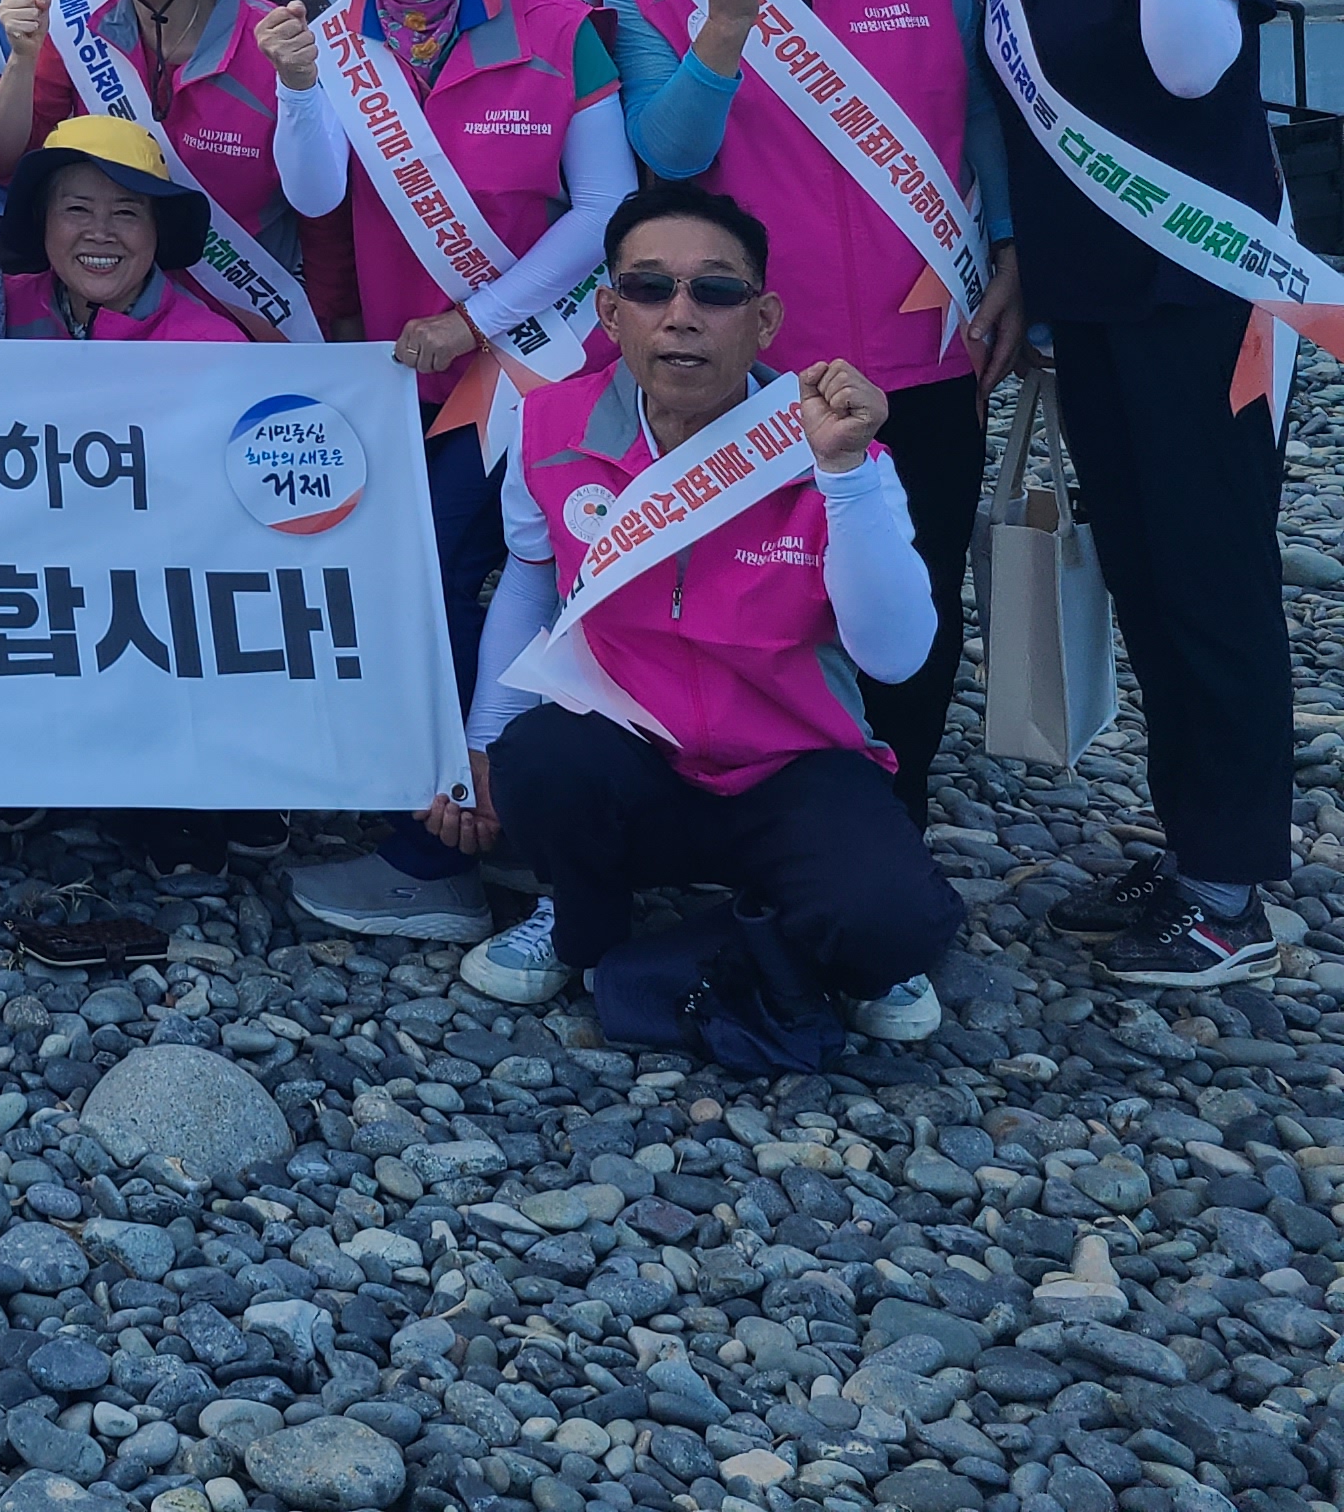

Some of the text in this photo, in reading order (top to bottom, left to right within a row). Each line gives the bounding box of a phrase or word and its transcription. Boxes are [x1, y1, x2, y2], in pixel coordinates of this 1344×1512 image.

[1057, 126, 1170, 218] 다함께
[1162, 202, 1311, 305] 동참합시다
[255, 423, 326, 444] 시민중심
[245, 447, 345, 468] 희망의 새로운
[262, 469, 331, 506] 거제
